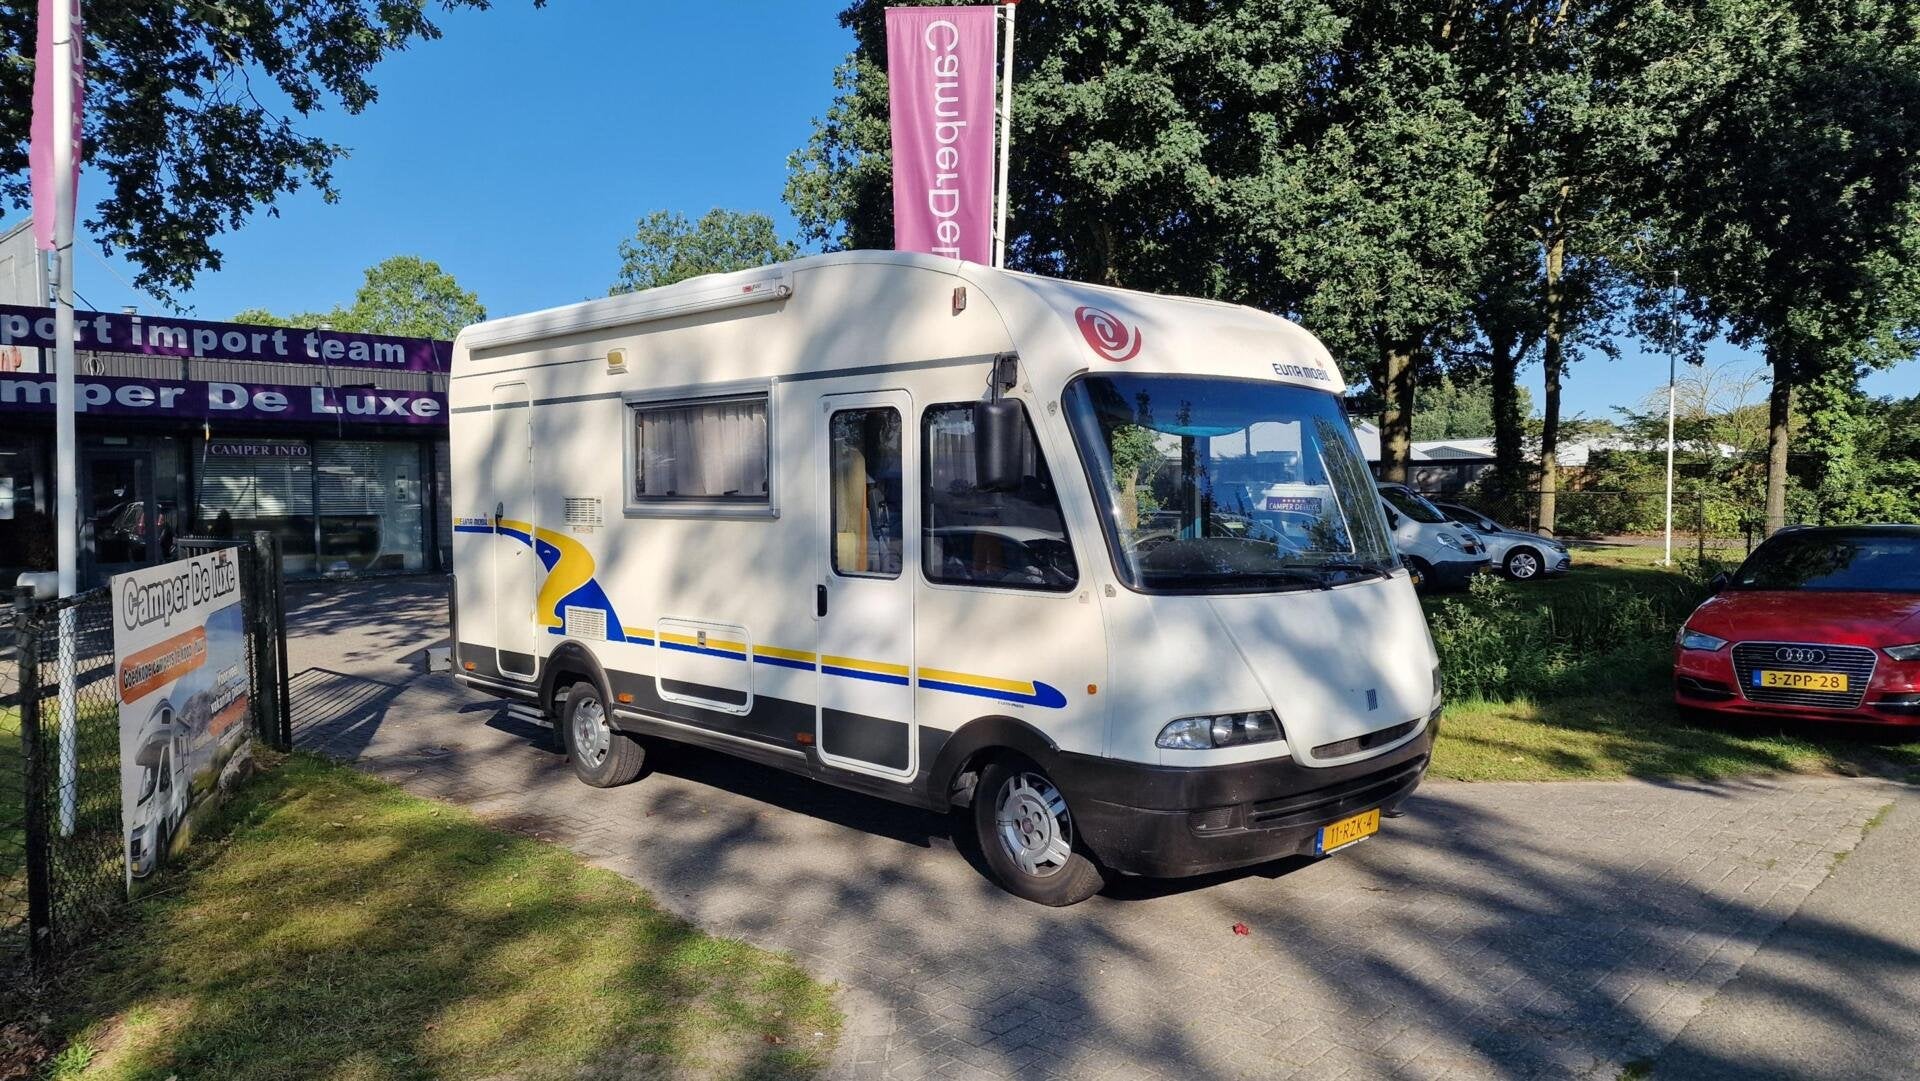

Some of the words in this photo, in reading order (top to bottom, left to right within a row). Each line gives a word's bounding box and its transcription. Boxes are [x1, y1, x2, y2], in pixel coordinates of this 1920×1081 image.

[131, 316, 288, 357] import
[304, 330, 406, 363] team
[208, 382, 288, 412] De
[311, 387, 440, 418] Luxe
[211, 444, 269, 456] CAMPER
[274, 446, 307, 456] INFO
[1269, 502, 1294, 511] CAMPER
[123, 577, 190, 631] Camper
[191, 561, 210, 606] De
[1769, 673, 1840, 688] 3-ZPP-28
[1331, 813, 1373, 844] 11-RZK-4
